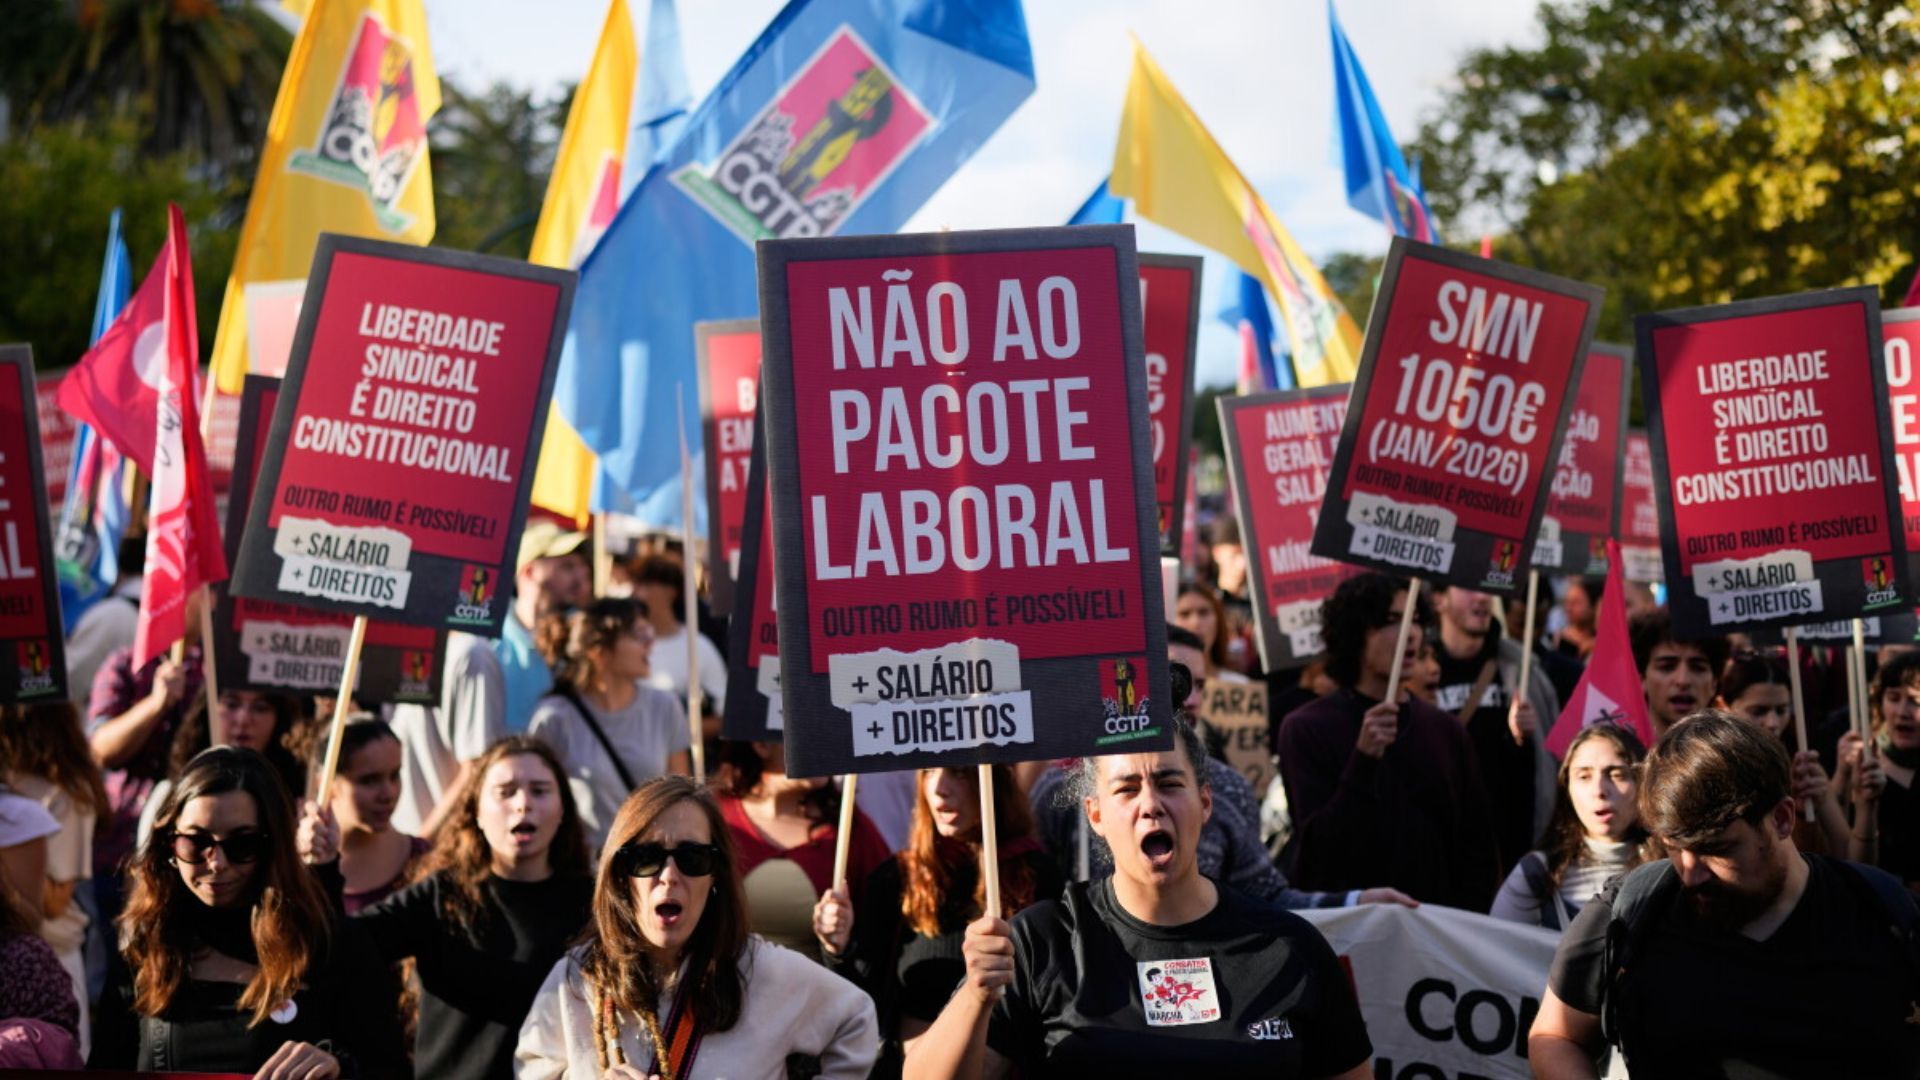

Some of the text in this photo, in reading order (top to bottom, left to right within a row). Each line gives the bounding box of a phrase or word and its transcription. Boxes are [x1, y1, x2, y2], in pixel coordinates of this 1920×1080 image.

[359, 302, 504, 356] LIBERDADE
[828, 269, 1081, 370] NÃO AO
[1429, 280, 1543, 363] SMN
[362, 344, 479, 394] SINDICAL
[1697, 350, 1829, 395] LIBERDADE
[350, 382, 476, 434] É DIREITO
[1394, 354, 1545, 444] 1050€
[1712, 389, 1823, 429] SINDICAL
[830, 376, 1096, 474] PACOTE
[1265, 403, 1348, 440] AUMENT
[294, 415, 512, 484] CONSTITUCIONAL
[1264, 437, 1329, 474] GERAL
[1369, 419, 1529, 496] (JAN/2026)
[1714, 423, 1828, 465] É DIREITO
[1356, 464, 1399, 490] OUTRO
[1404, 475, 1442, 500] RUMO
[1445, 482, 1456, 502] É
[1457, 485, 1525, 519] POSSÍVEL!
[1676, 453, 1876, 506] CONSTITUCIONAL
[284, 486, 497, 540] OUTRO RUMO É POSSÍVEL!
[811, 478, 1130, 581] LABORAL
[1373, 506, 1440, 538] SALÁRIO
[307, 532, 390, 567] SALÁRIO
[1373, 534, 1444, 566] DIREITOS
[1688, 532, 1737, 556] OUTRO
[1740, 526, 1786, 551] RUMO
[1789, 518, 1800, 543] É
[1802, 514, 1878, 541] POSSÍVEL!
[308, 565, 397, 601] DIREITOS
[1723, 561, 1796, 592] SALÁRIO
[1866, 590, 1896, 603] CGTP
[454, 604, 490, 620] CGTP
[823, 604, 900, 638] OUTRO
[908, 597, 977, 632] RUMO
[985, 588, 1000, 627] É
[1006, 585, 1125, 625] POSSÍVEL!
[1733, 588, 1813, 618] DIREITOS
[269, 630, 341, 659] SALÁRIO
[877, 655, 993, 701] SALÁRIO
[1202, 686, 1265, 718] ARA
[893, 702, 1016, 746] DIREITOS
[1104, 715, 1150, 734] CGTP
[1148, 1010, 1184, 1021] MARCHA
